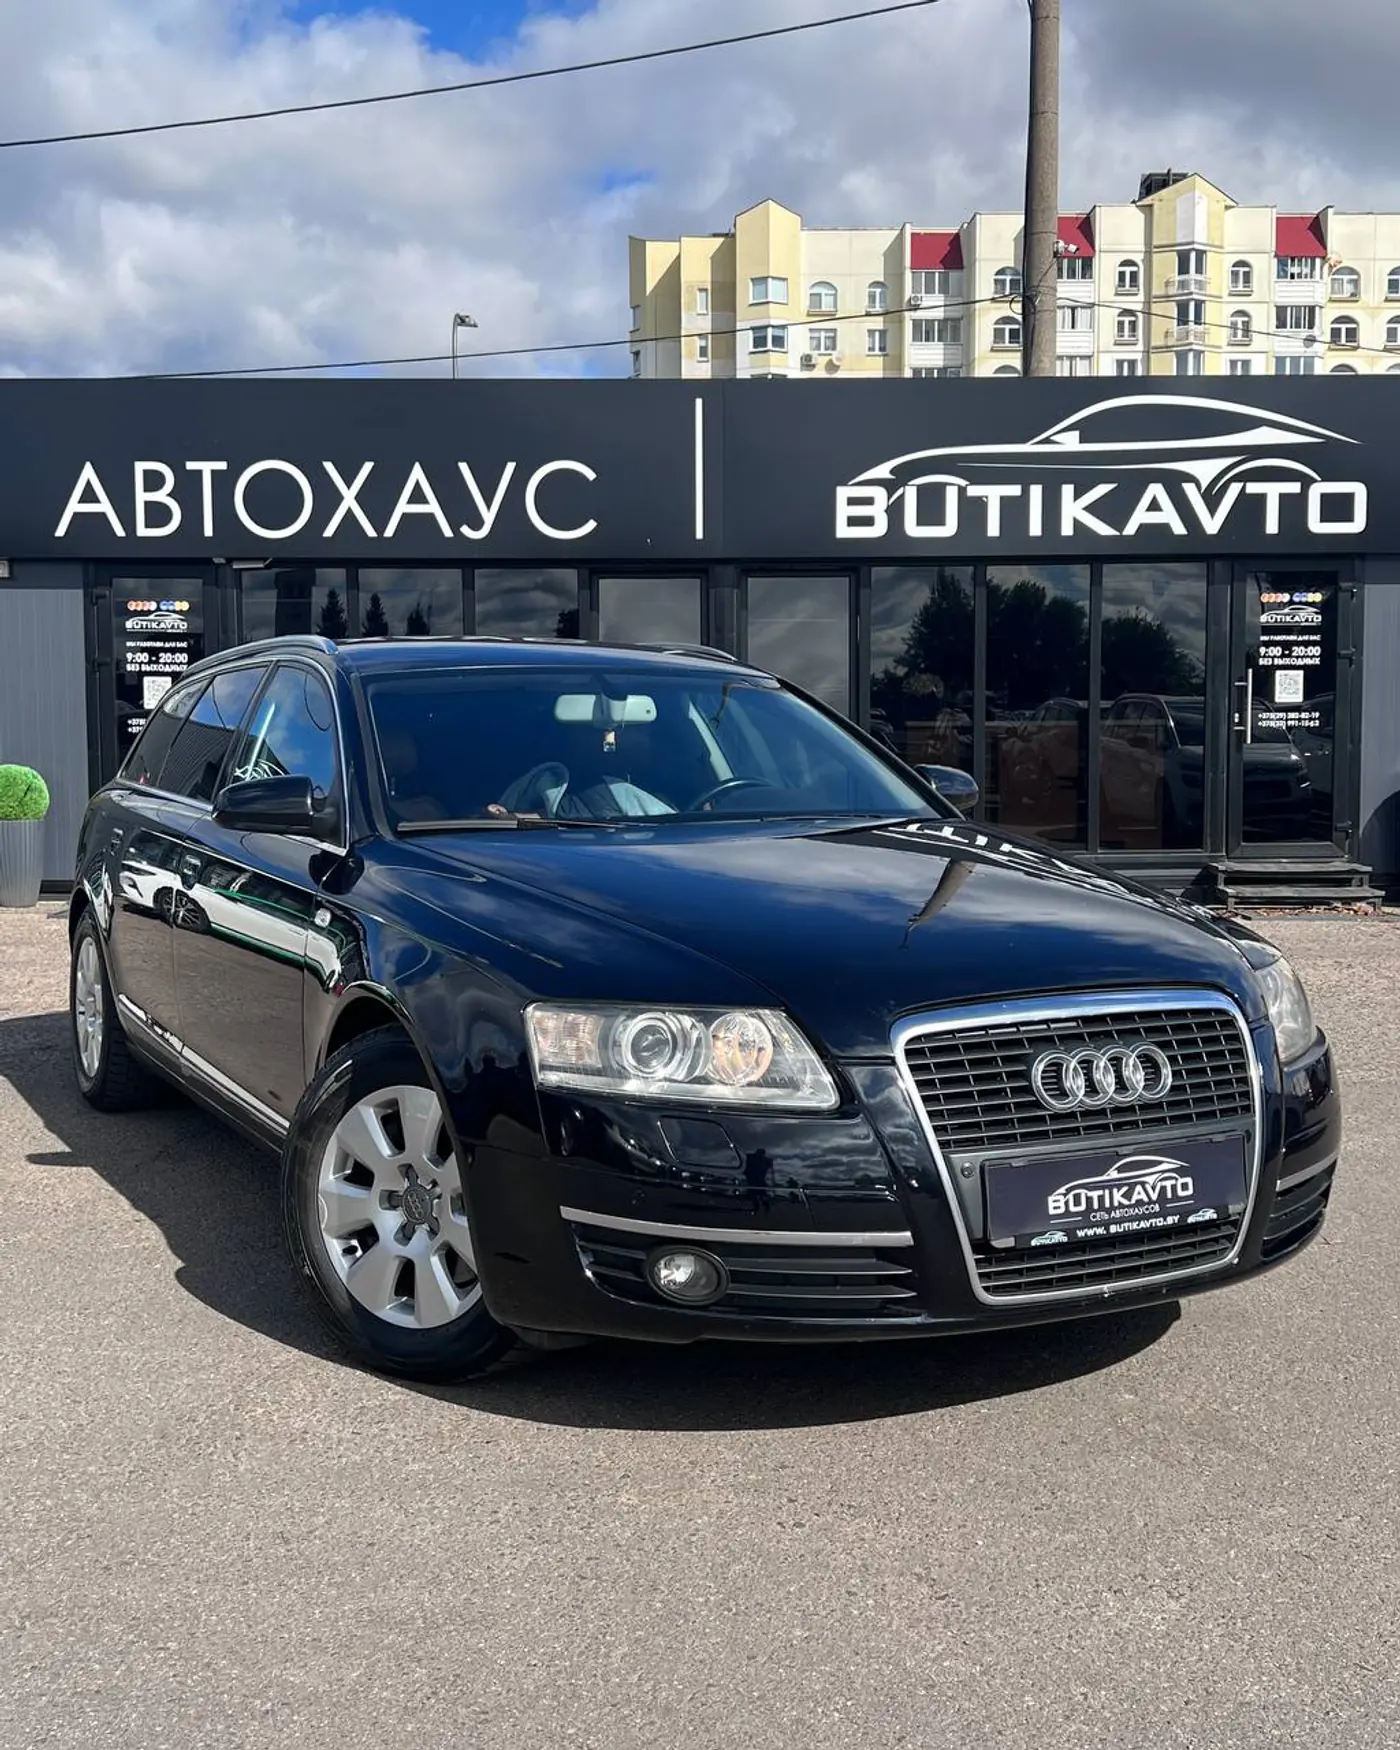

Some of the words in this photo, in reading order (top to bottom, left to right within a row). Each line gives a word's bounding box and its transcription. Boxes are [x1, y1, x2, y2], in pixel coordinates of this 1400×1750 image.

[54, 458, 598, 540] АВТОХАУС
[835, 480, 1368, 539] BUTIKAVTO
[126, 652, 149, 663] 9:00
[158, 652, 189, 663] 20:00
[1259, 646, 1282, 656] 9:00
[1291, 646, 1321, 656] 20:00
[126, 664, 140, 672] БЕЗ
[1259, 657, 1273, 666] БЕЗ
[1273, 657, 1321, 666] ВЫХОДНЫХ
[1047, 1177, 1194, 1215] BUTIKAVTO
[1110, 1203, 1161, 1219] АВТОХАУСОВ
[1076, 1225, 1107, 1238] WWW.
[1109, 1214, 1180, 1234] BUTIKAVTO.BY
